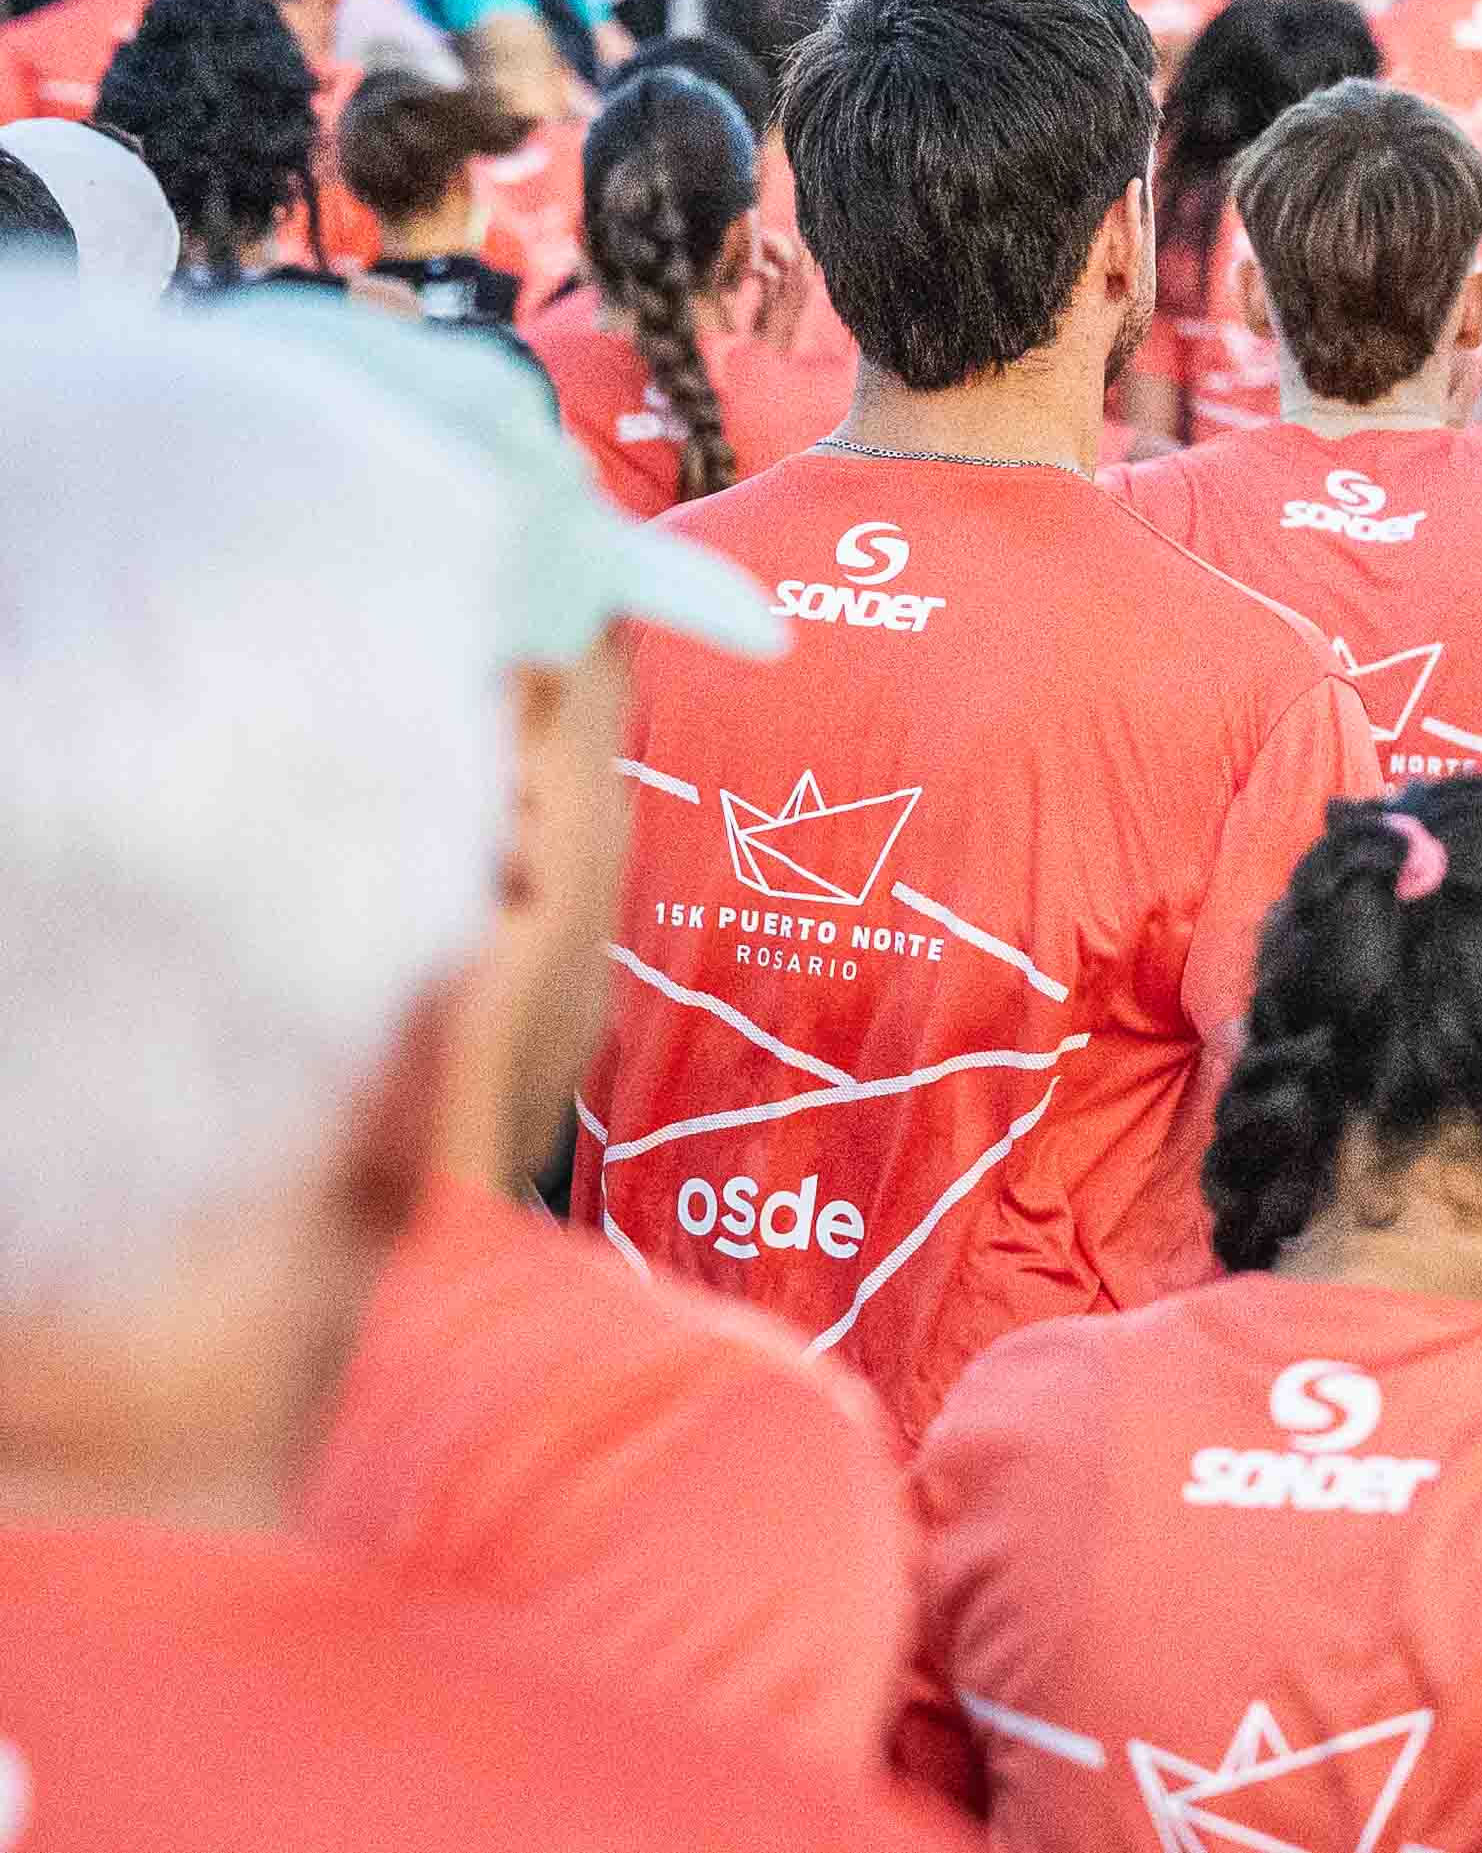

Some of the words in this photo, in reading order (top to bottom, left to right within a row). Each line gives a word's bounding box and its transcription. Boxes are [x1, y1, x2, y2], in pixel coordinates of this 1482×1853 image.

[656, 902, 704, 929] 15K
[718, 906, 837, 944] PUERTO
[852, 926, 945, 961] NORTE
[736, 945, 857, 980] ROSARIO
[678, 1174, 865, 1259] osde
